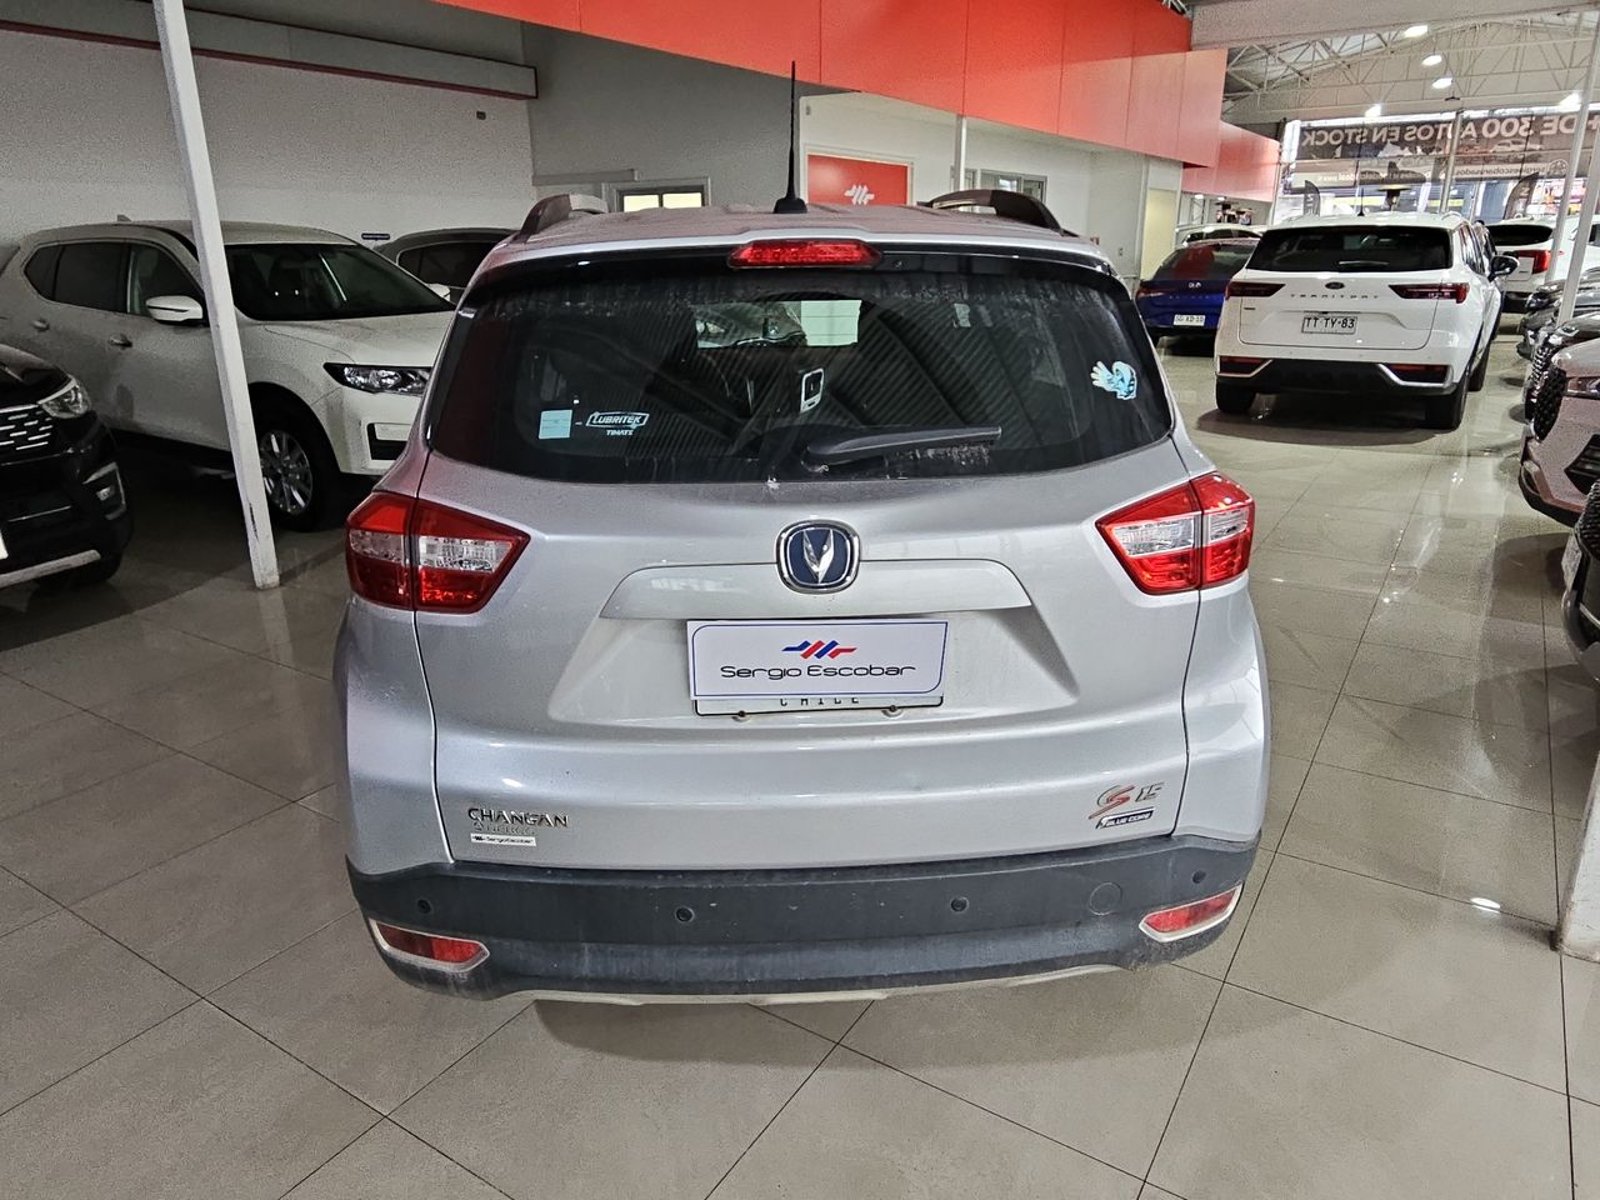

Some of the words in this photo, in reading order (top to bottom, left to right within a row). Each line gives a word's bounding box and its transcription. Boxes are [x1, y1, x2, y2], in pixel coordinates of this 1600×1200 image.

[591, 412, 642, 426] LUBRITEK
[720, 665, 802, 681] Sergio
[806, 664, 916, 677] Escobar
[468, 808, 569, 828] CHANGAN
